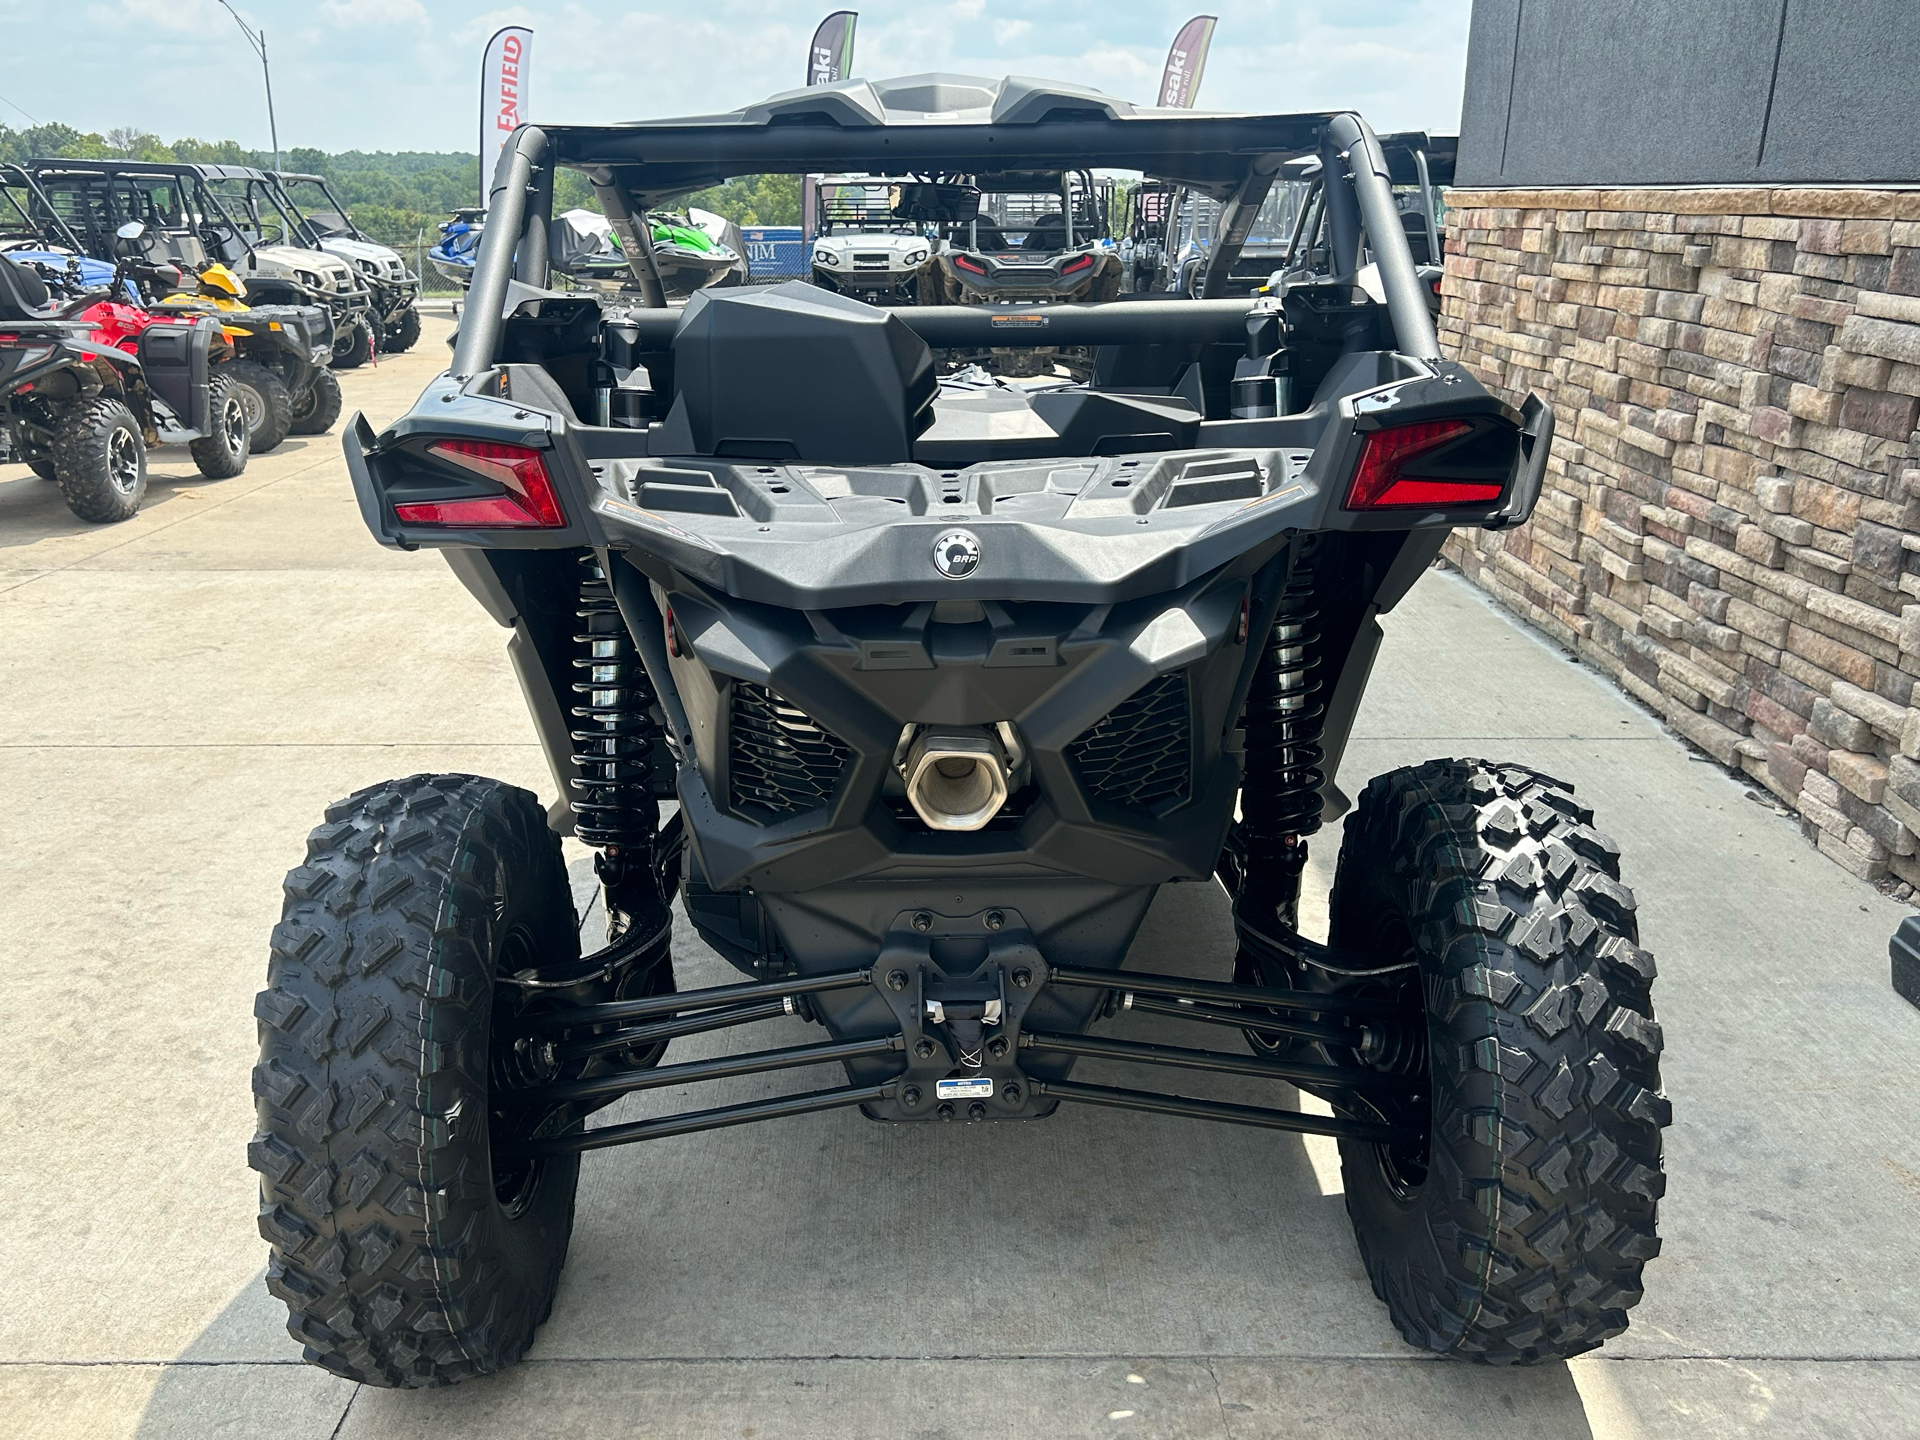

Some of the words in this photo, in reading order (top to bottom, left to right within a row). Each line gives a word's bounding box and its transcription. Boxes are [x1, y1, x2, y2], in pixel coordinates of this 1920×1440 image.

[497, 35, 522, 132] ENFIELD
[1165, 48, 1188, 108] saki
[953, 555, 977, 563] BRP
